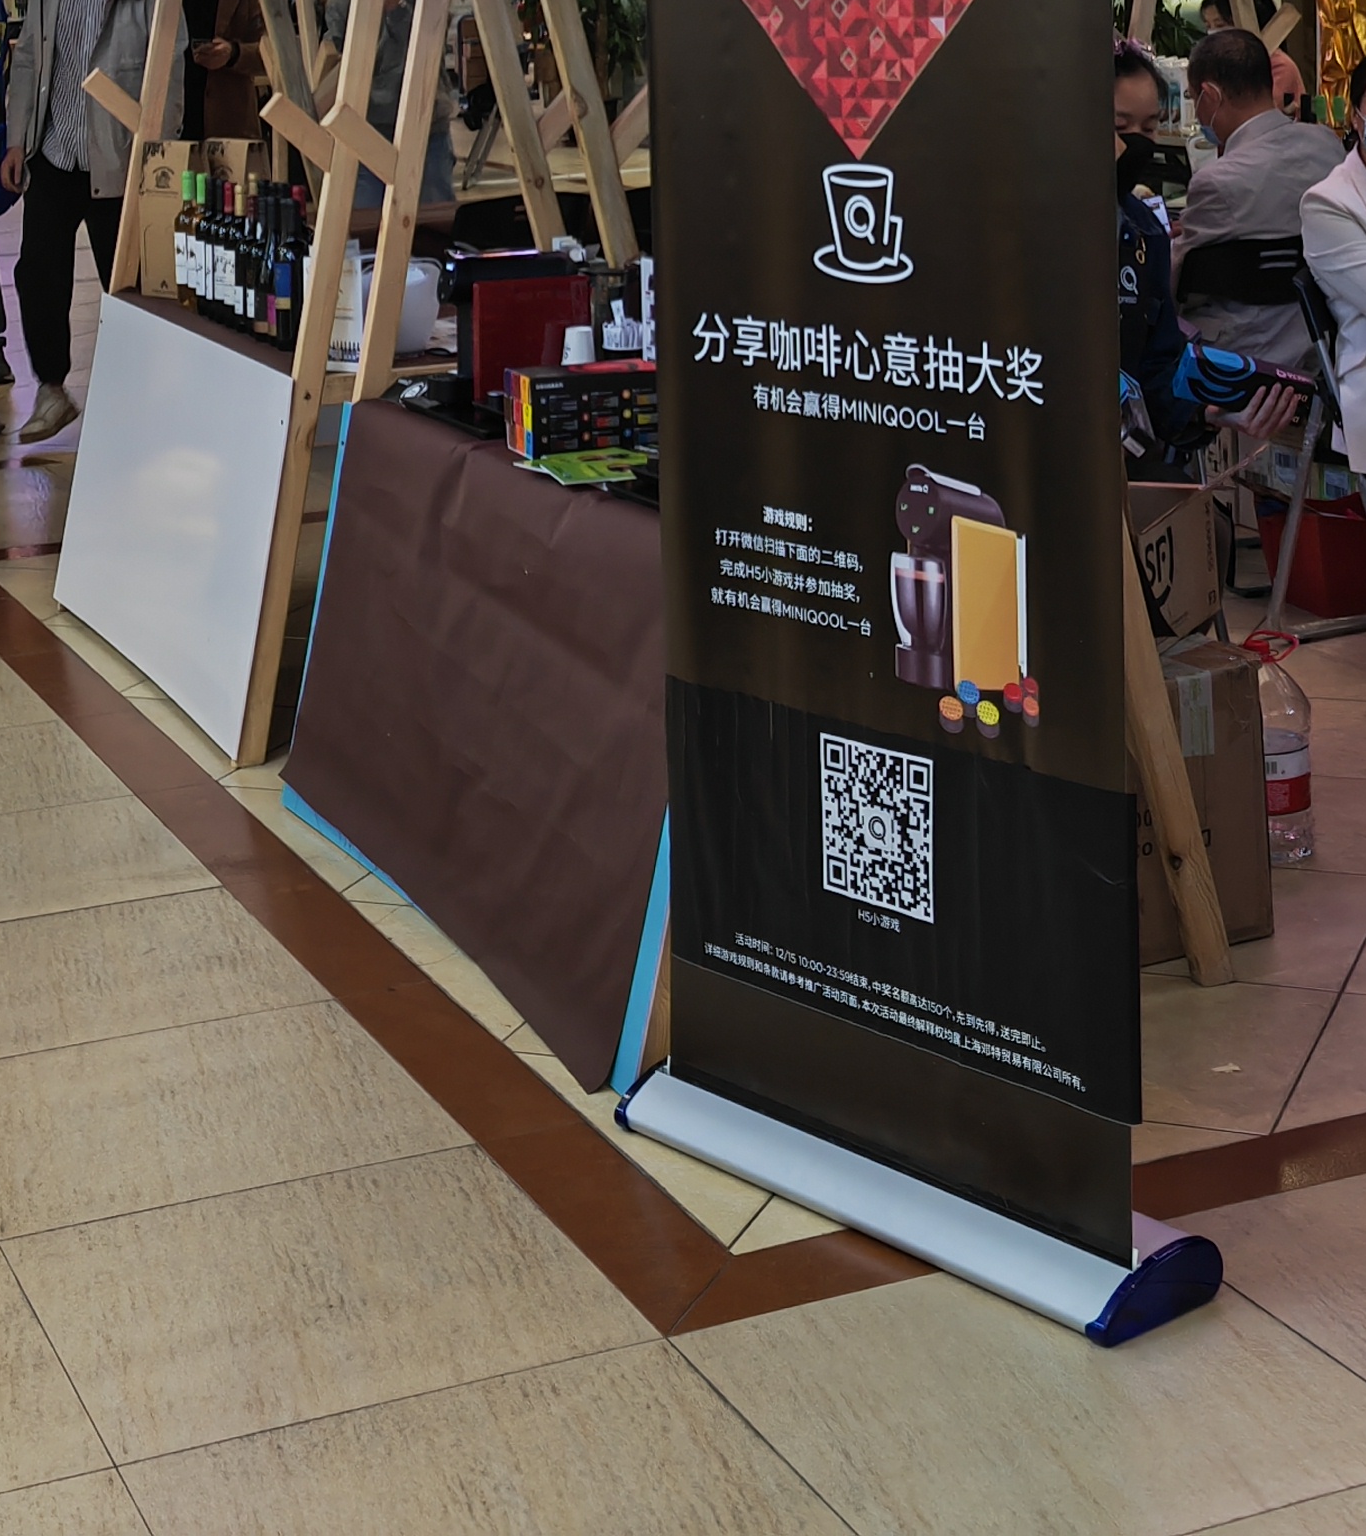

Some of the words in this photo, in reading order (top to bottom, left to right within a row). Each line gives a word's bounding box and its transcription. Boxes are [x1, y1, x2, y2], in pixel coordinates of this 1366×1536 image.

[692, 312, 1044, 406] 分享咖啡心意抽大奖
[753, 383, 986, 442] 有机会赢得MINIQOOL一台
[711, 587, 872, 637] 就有机会赢得MINIQOOL一台
[857, 908, 901, 934] H5小游戏
